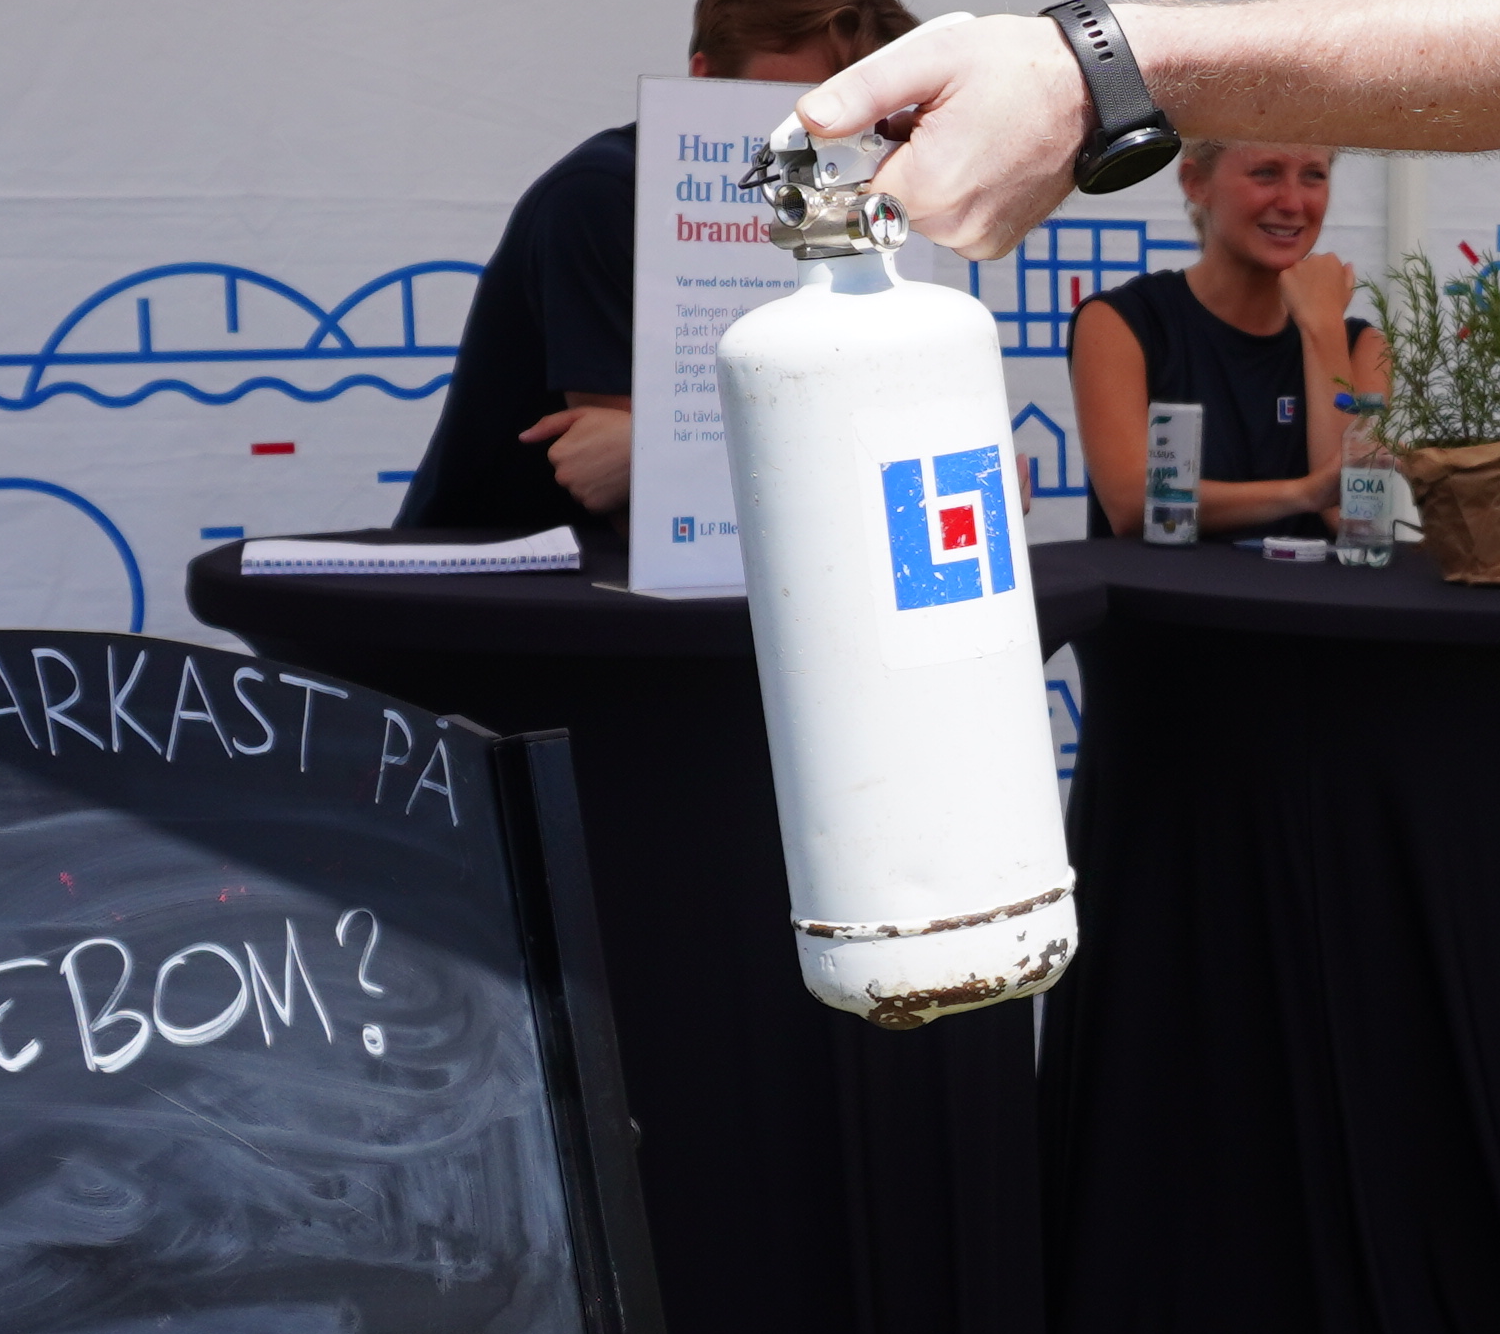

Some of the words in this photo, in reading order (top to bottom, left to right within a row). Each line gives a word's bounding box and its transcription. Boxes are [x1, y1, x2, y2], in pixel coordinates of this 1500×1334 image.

[678, 134, 734, 163] Hur
[676, 174, 713, 202] du
[676, 276, 693, 287] Var
[696, 276, 717, 287] med
[719, 276, 737, 287] och
[740, 276, 764, 288] tävla
[766, 280, 781, 288] om
[784, 280, 795, 289] en
[676, 304, 728, 321] Tävlingen
[675, 323, 689, 339] på
[691, 325, 708, 336] att
[674, 361, 706, 378] länge
[674, 380, 688, 397] på
[691, 380, 716, 393] raka
[674, 410, 690, 423] Du
[693, 409, 722, 423] tävla
[674, 428, 693, 441] här
[1347, 478, 1385, 494] LOKA
[700, 522, 717, 536] LF
[719, 522, 740, 535] Ble
[373, 708, 465, 828] PÅ
